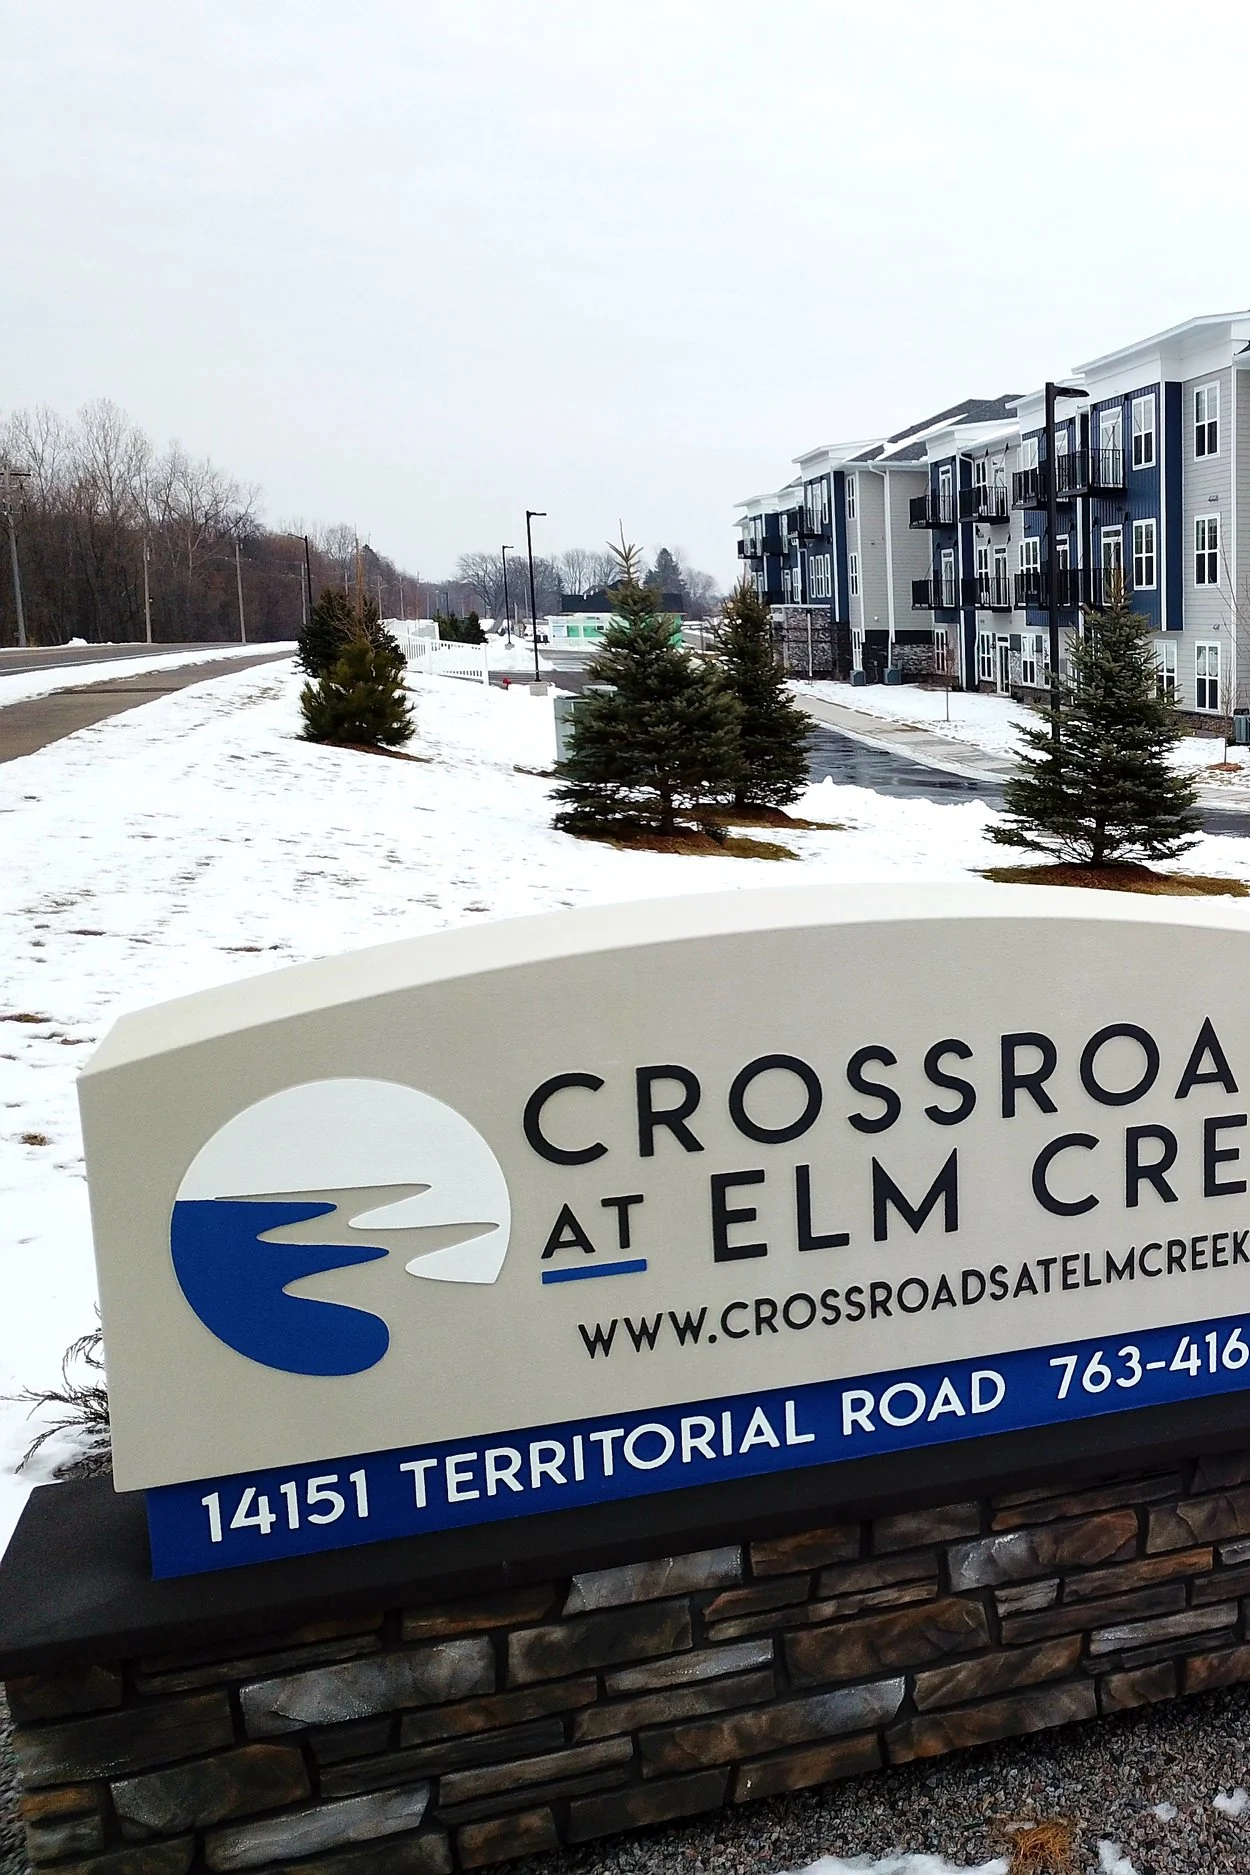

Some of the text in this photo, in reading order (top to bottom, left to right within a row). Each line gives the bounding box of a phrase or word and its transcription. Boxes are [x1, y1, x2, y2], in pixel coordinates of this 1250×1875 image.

[540, 1194, 645, 1261] AT
[710, 1147, 959, 1263] ELM
[200, 1469, 370, 1543] 14151
[399, 1400, 815, 1510] TERRITORIAL
[842, 1370, 1006, 1436] ROAD
